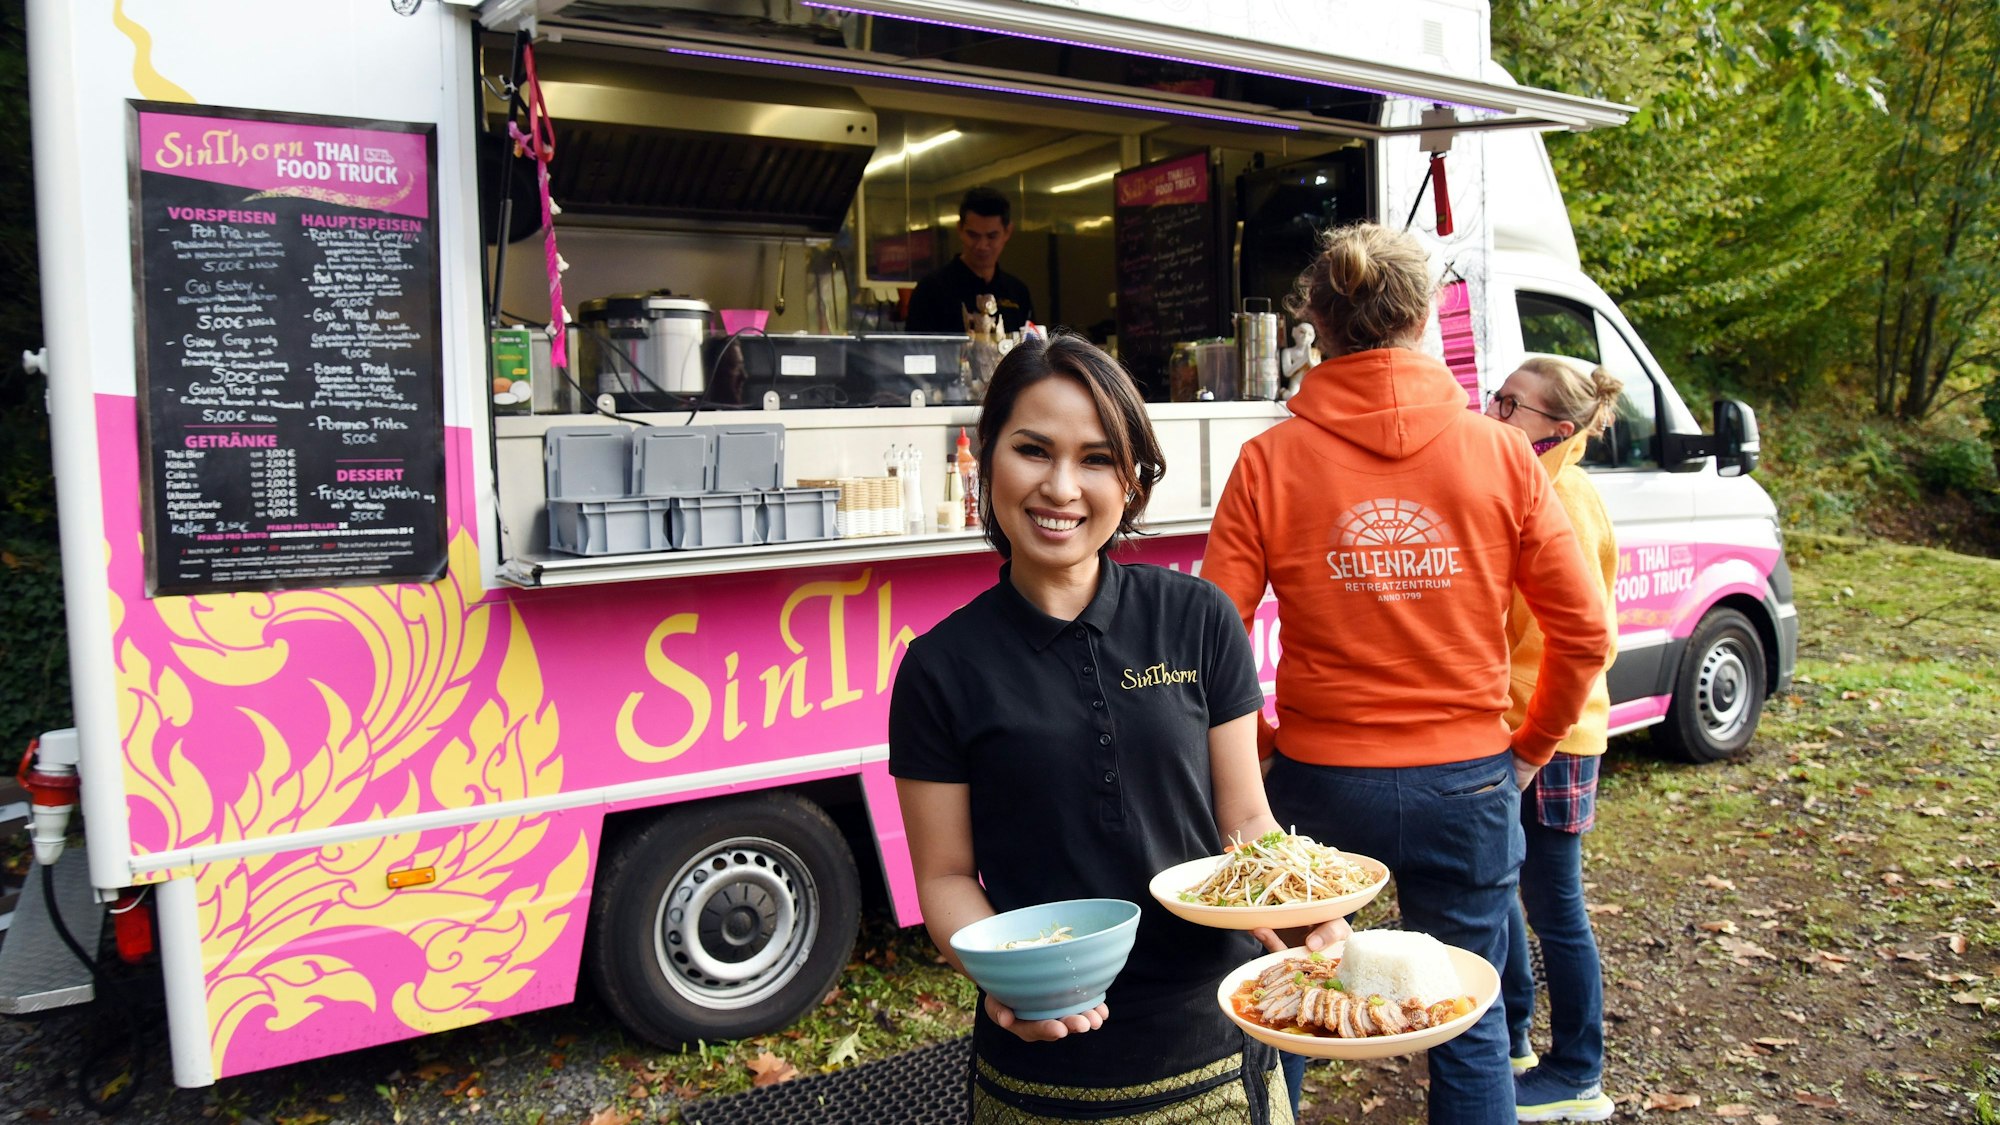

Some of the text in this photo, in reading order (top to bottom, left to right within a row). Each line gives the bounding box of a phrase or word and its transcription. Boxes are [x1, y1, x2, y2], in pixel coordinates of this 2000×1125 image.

[155, 128, 304, 169] SinThorn
[313, 141, 360, 162] THAI
[276, 158, 399, 185] FOOD TRUCK
[1167, 167, 1184, 181] THAI
[1155, 176, 1197, 197] FOOD TRUCK
[167, 206, 277, 225] VORSPEISEN
[301, 213, 423, 232] HAUPTSPEISEN
[190, 223, 217, 239] Poh
[345, 229, 370, 240] Thai
[373, 230, 404, 243] Curry
[201, 260, 246, 273] 5,00€
[185, 279, 254, 295] Gai Satay
[312, 307, 337, 322] Gai
[196, 315, 245, 332] 5,00€
[202, 409, 248, 424] 5,00€
[184, 431, 278, 449] GETRÄNKE
[342, 432, 378, 445] 5,00€
[165, 469, 188, 480] Cola
[336, 468, 405, 482] DESSERT
[166, 480, 192, 490] Fanta
[317, 484, 367, 501] Frische
[368, 484, 421, 500] Waffeln
[349, 511, 385, 522] 5,00€
[1326, 547, 1463, 580] SELLENRADE
[1637, 543, 1670, 573] THAI
[1345, 579, 1452, 592] RETREATZENTRUM
[1652, 566, 1695, 597] TRUCK
[1378, 592, 1422, 602] ANNO 1799
[615, 566, 920, 764] SinTh
[1121, 662, 1198, 690] SinThorn
